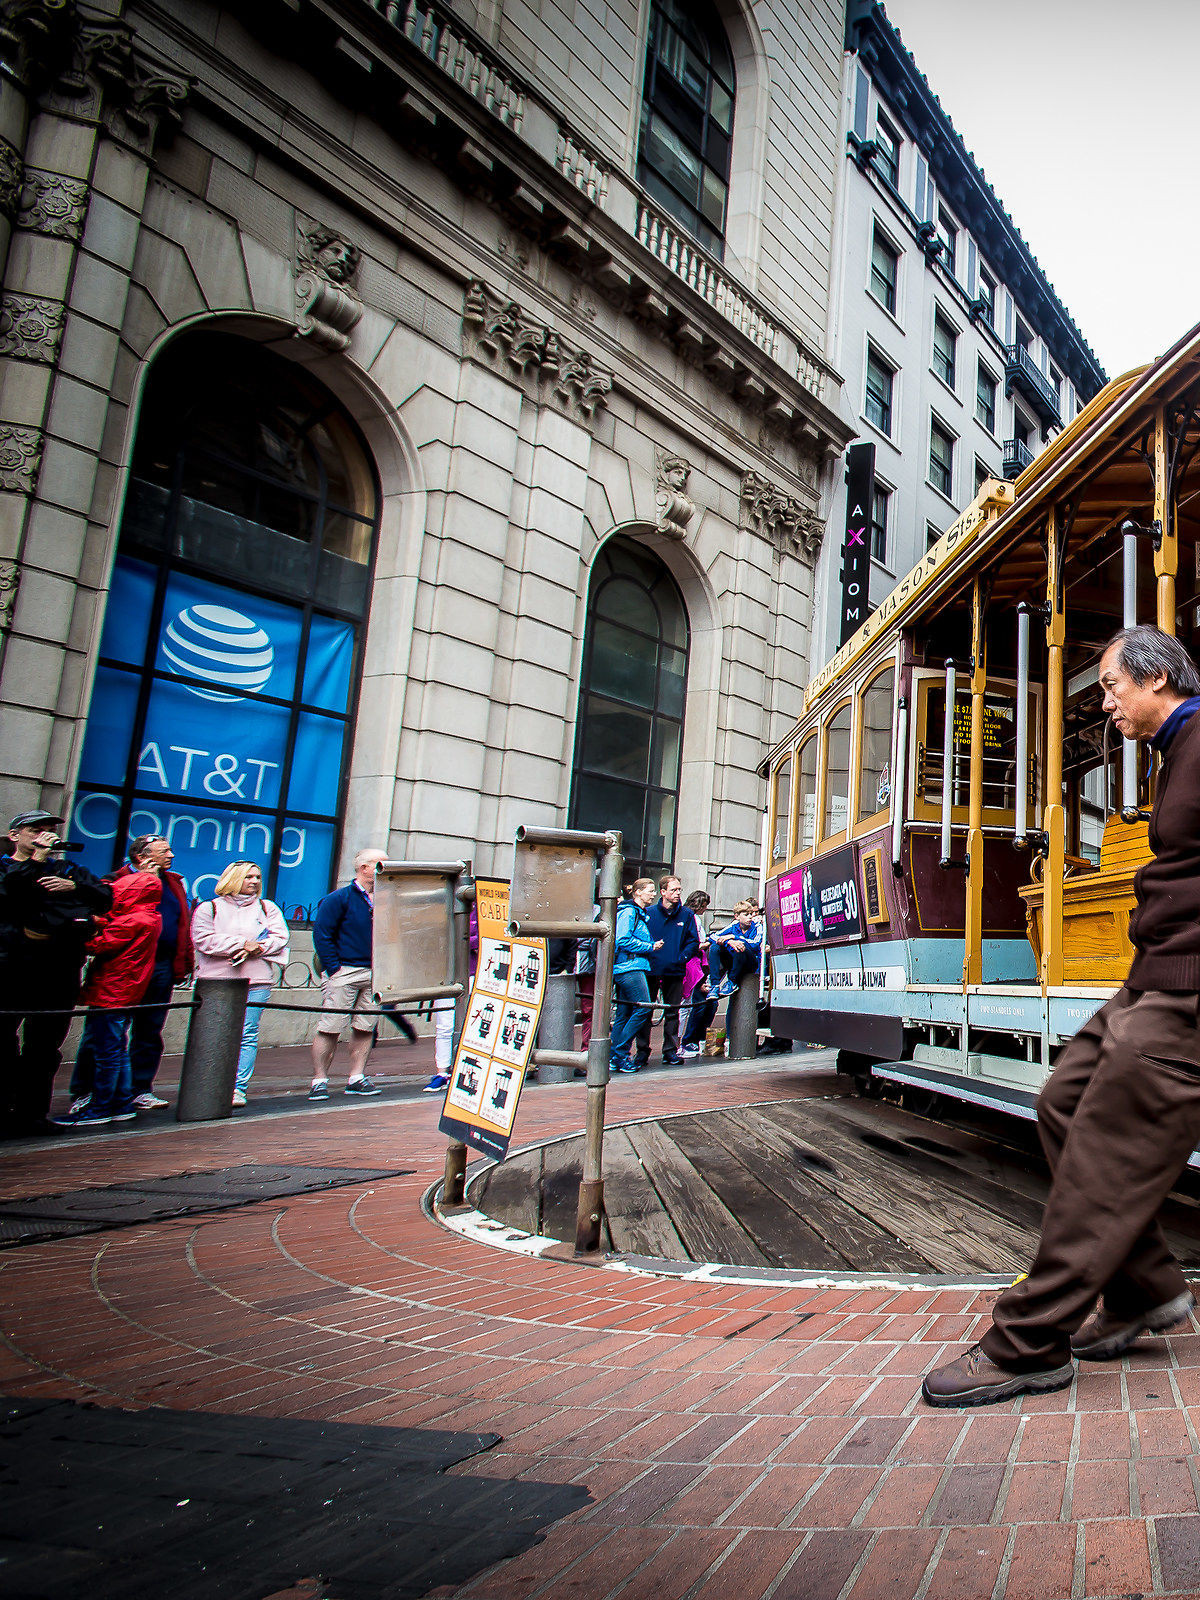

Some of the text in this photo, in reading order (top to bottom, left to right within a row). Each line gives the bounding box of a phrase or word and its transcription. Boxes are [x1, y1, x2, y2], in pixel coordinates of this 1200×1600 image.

[847, 504, 866, 621] AXIOM
[811, 641, 856, 696] POWELL
[862, 623, 871, 642] &
[877, 546, 939, 625] MASON
[137, 741, 280, 801] AT&T
[74, 792, 307, 868] Coming
[480, 901, 509, 921] CABL
[794, 973, 822, 987] FANCISCO
